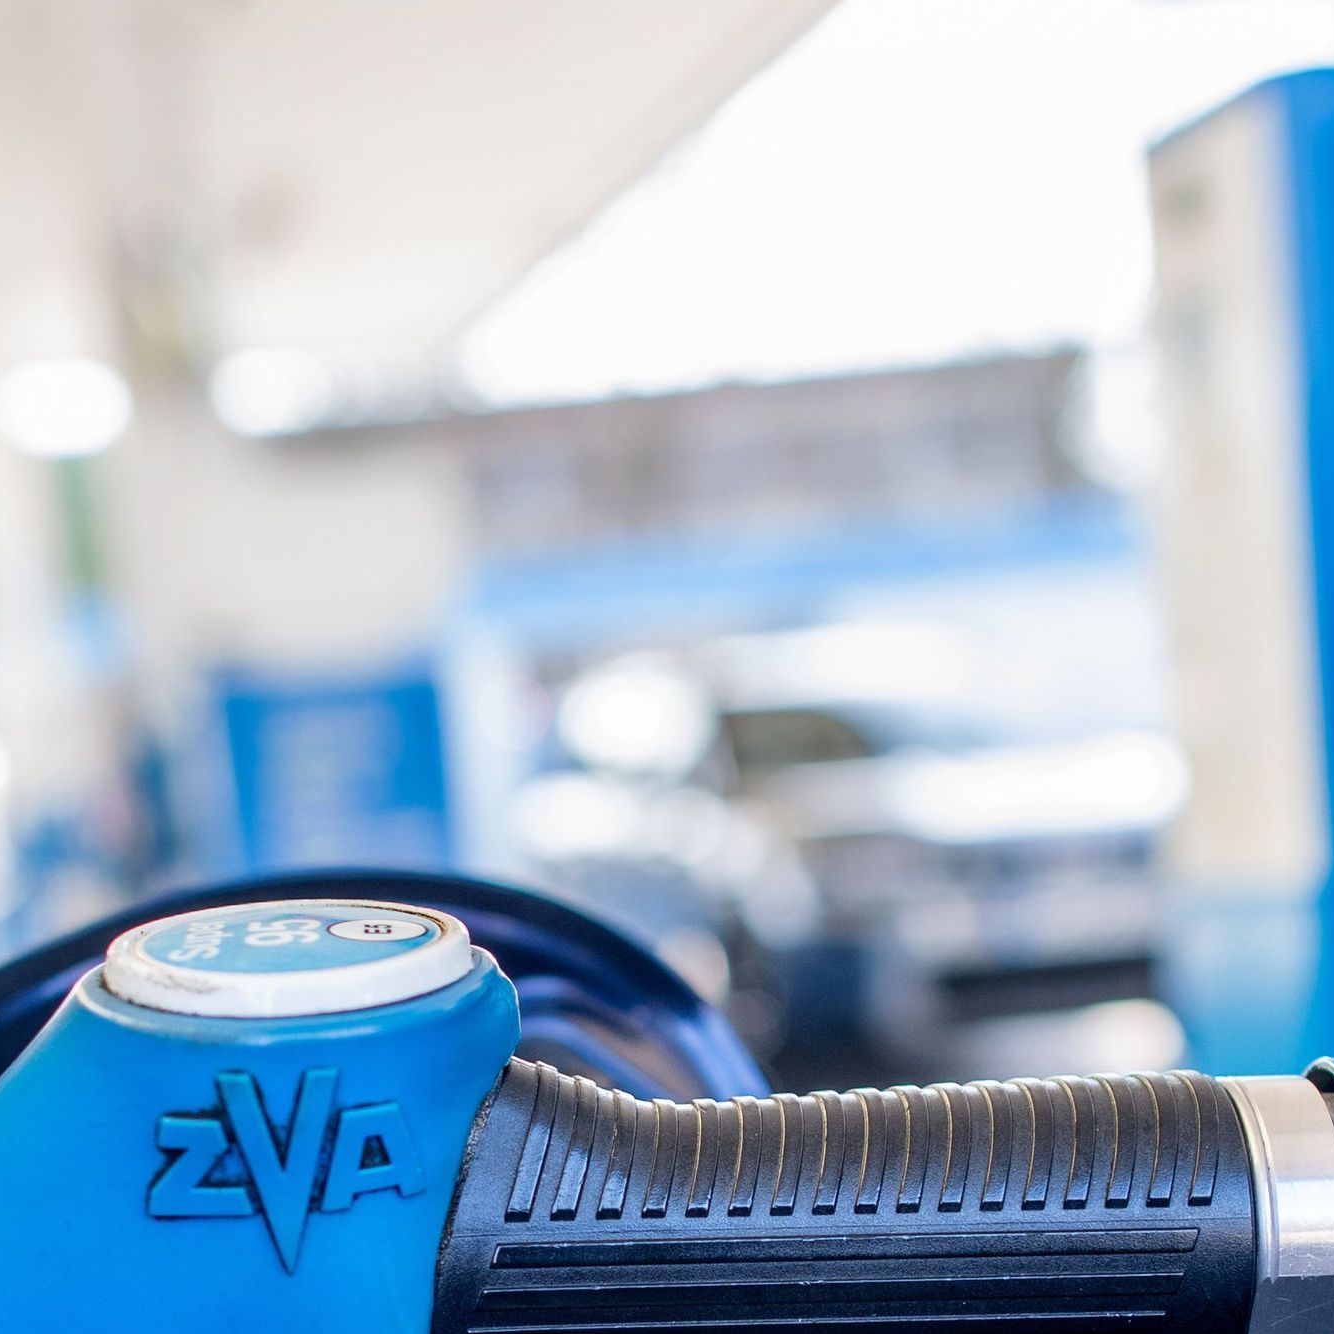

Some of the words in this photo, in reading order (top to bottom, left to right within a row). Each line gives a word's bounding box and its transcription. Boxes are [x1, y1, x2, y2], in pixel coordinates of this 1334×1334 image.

[168, 920, 233, 961] Super
[244, 918, 322, 947] 95
[364, 923, 392, 934] E5
[146, 1066, 426, 1277] ZVA
